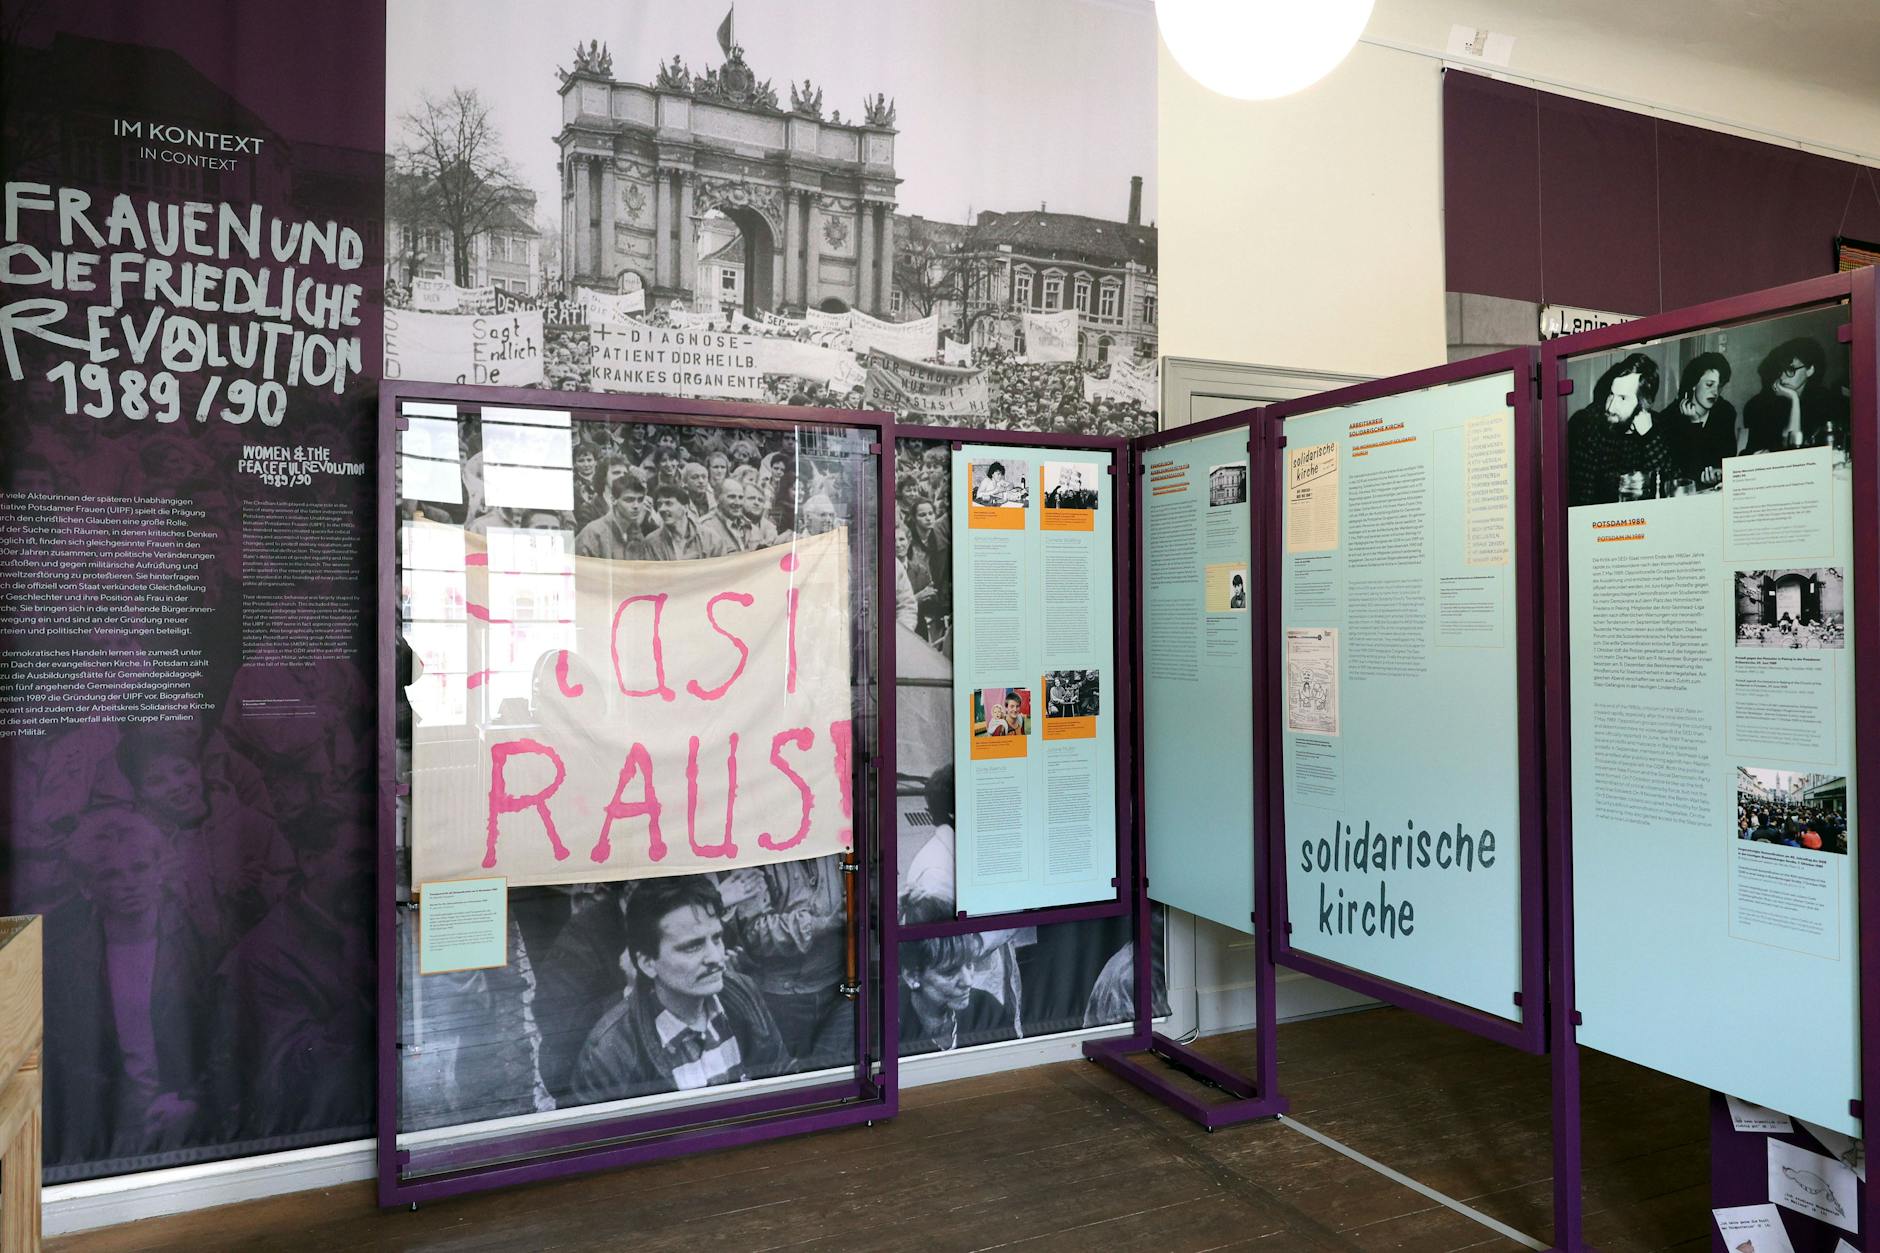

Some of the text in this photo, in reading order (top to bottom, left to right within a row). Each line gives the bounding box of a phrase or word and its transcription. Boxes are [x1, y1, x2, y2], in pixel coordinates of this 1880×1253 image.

[114, 120, 264, 154] IM KONTEXT
[140, 147, 238, 172] IN CONTEXT
[5, 181, 364, 270] FRAUEN UND
[0, 242, 363, 330] DIE FRIEDLICHE
[473, 318, 520, 342] Sagt
[0, 298, 363, 394] REVOLUTION
[473, 338, 537, 362] Endlich
[590, 346, 666, 364] PATIENT
[672, 351, 701, 366] DDR
[592, 366, 667, 384] KRANKES
[672, 372, 724, 386] ORGAN
[243, 445, 330, 462] WOMEN & THE
[1293, 442, 1335, 468] solidarische
[238, 459, 365, 476] PEACEFUL REVOLUTION
[1296, 463, 1318, 480] kirche
[1592, 519, 1627, 528] POTSDAM
[1301, 818, 1496, 874] solidarische
[1319, 880, 1414, 940] kirche
